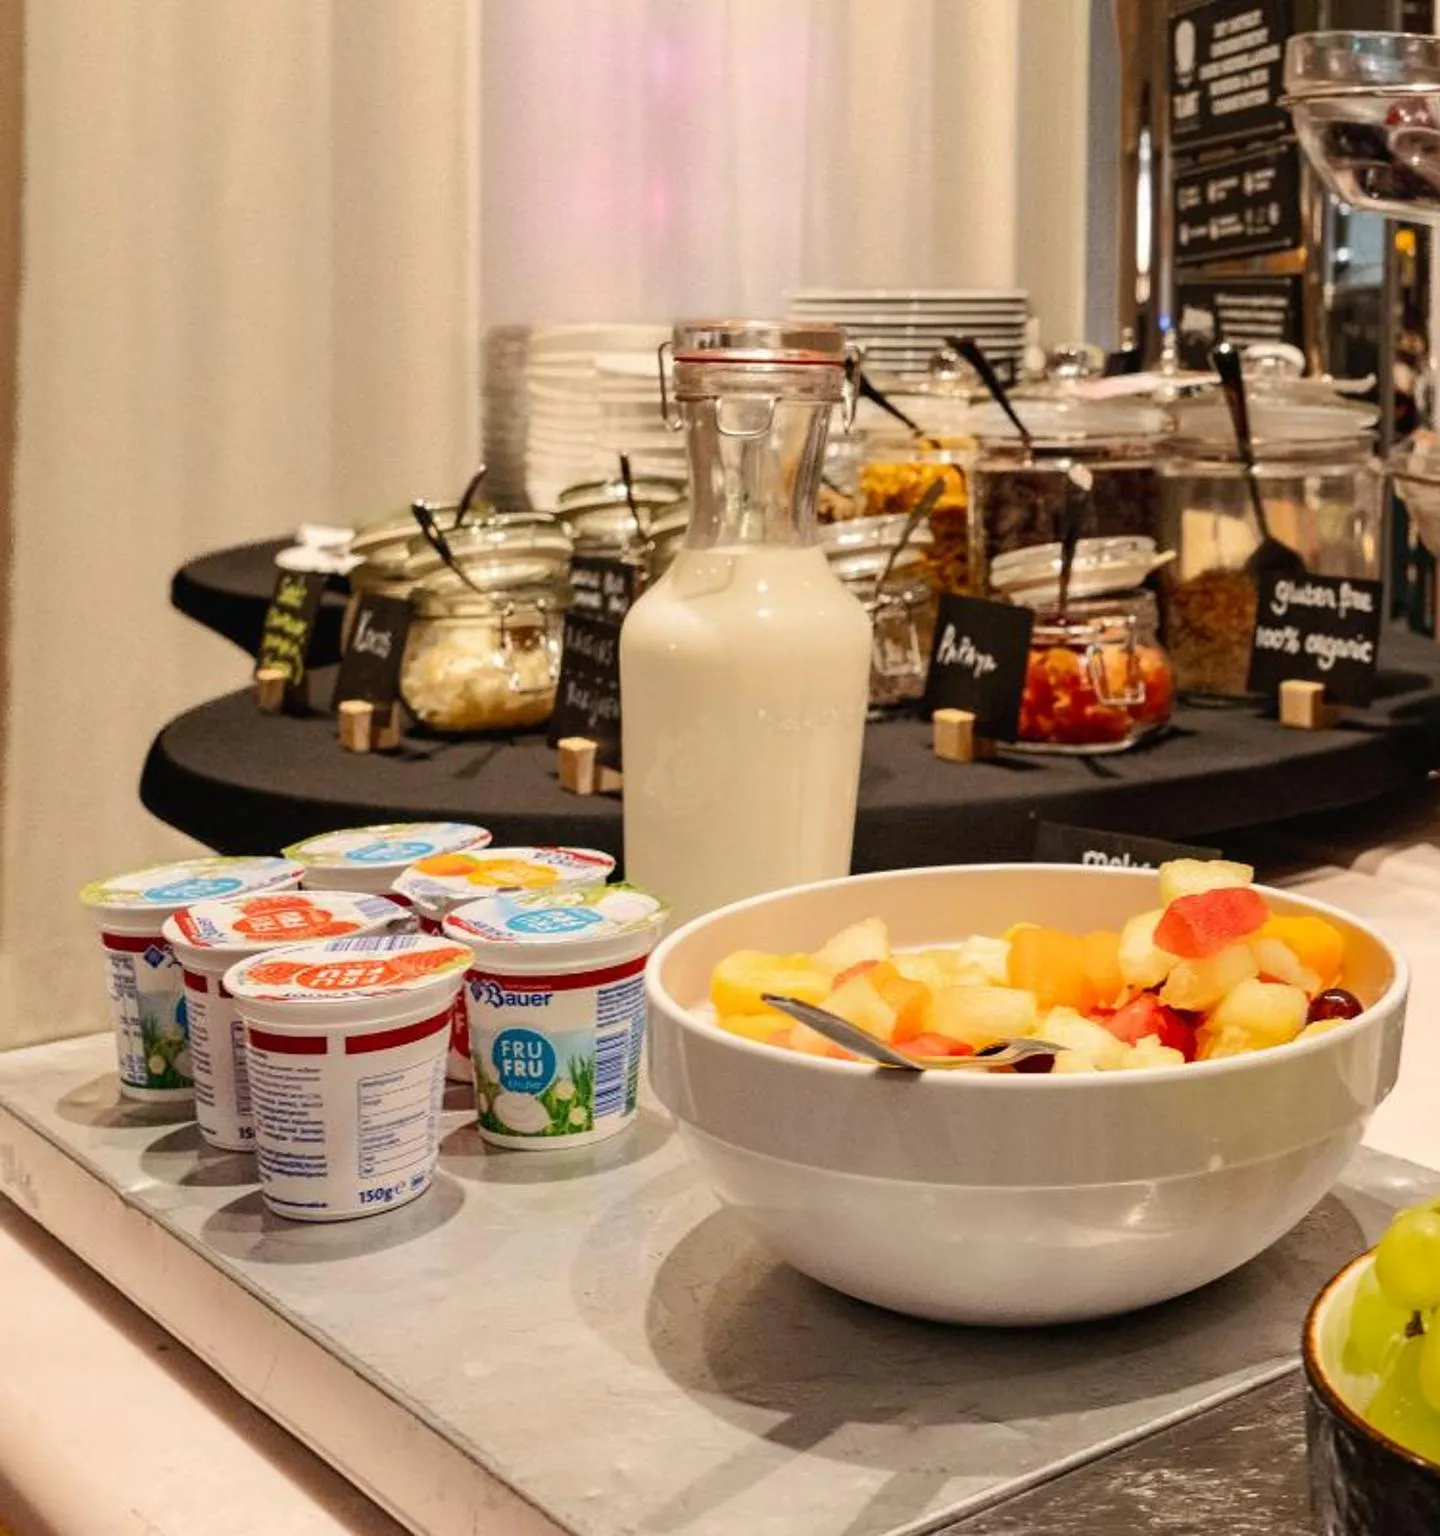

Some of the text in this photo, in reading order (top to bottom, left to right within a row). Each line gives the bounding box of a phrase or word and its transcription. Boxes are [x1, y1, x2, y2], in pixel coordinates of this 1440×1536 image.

[1255, 625, 1374, 671] 100% organic
[484, 982, 553, 1008] Bauer
[501, 1040, 543, 1059] FRU
[502, 1059, 544, 1078] FRU
[358, 1187, 393, 1204] 150g
